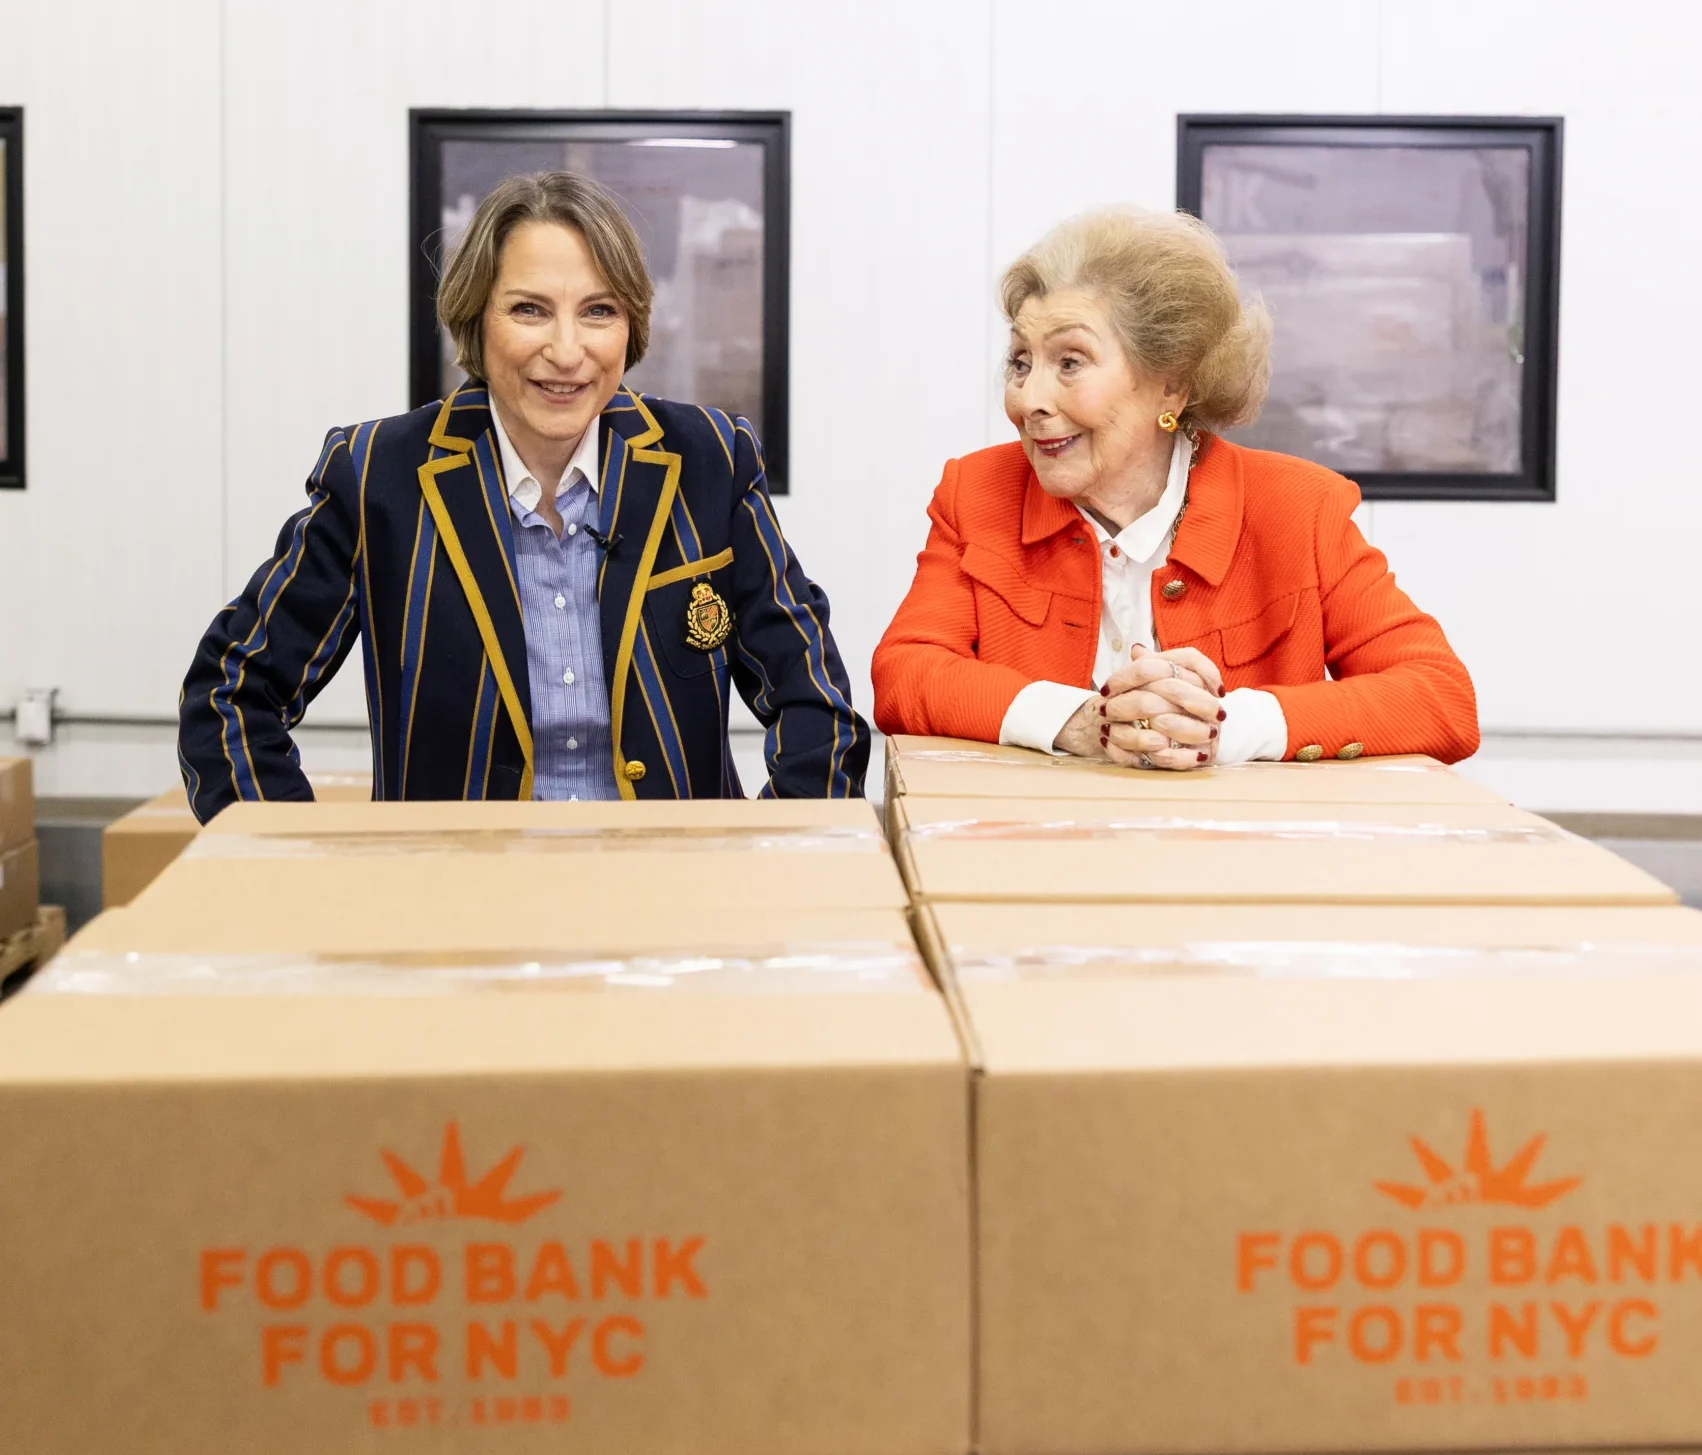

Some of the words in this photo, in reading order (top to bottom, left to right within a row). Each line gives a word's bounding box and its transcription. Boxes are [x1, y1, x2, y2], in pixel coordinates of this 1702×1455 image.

[198, 1243, 443, 1313] FOOD
[463, 1235, 708, 1305] BANK
[1235, 1228, 1467, 1293] FOOD
[1487, 1223, 1702, 1287] BANK
[262, 1322, 439, 1387] FOR
[464, 1314, 645, 1381] NYC
[1294, 1302, 1463, 1366] FOR
[1487, 1298, 1659, 1361] NYC
